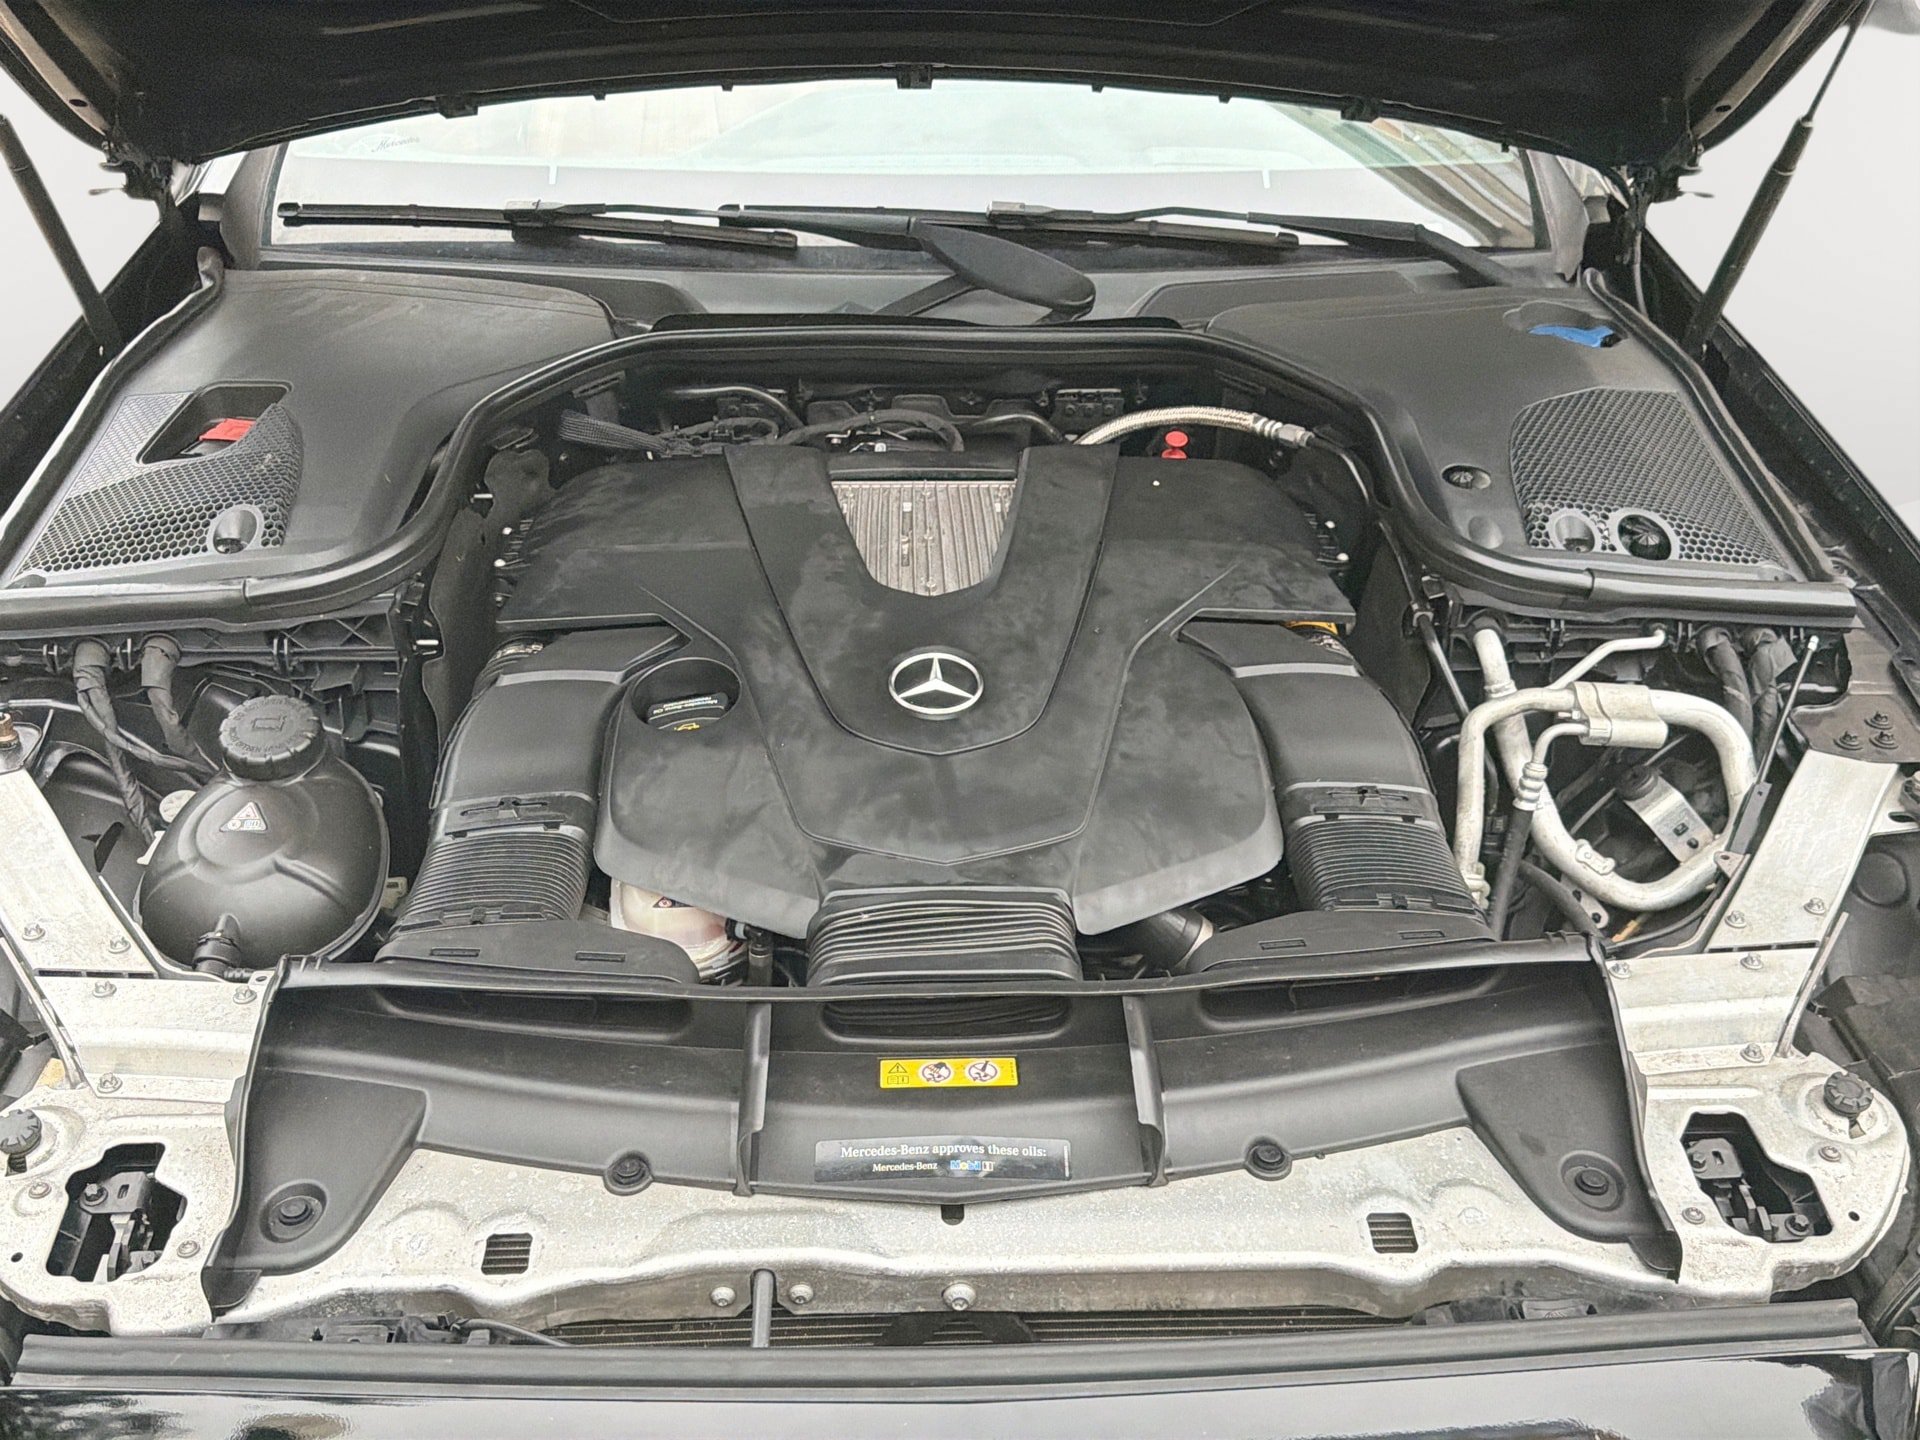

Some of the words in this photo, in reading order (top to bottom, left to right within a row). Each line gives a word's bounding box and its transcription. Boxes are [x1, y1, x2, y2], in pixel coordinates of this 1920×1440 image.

[840, 1144, 930, 1158] Mercedes-Benz
[932, 1144, 985, 1158] approves
[988, 1144, 1020, 1157] these
[1022, 1145, 1047, 1157] oils:
[872, 1161, 938, 1172] Mercedes-Benz
[949, 1159, 981, 1172] Mobil
